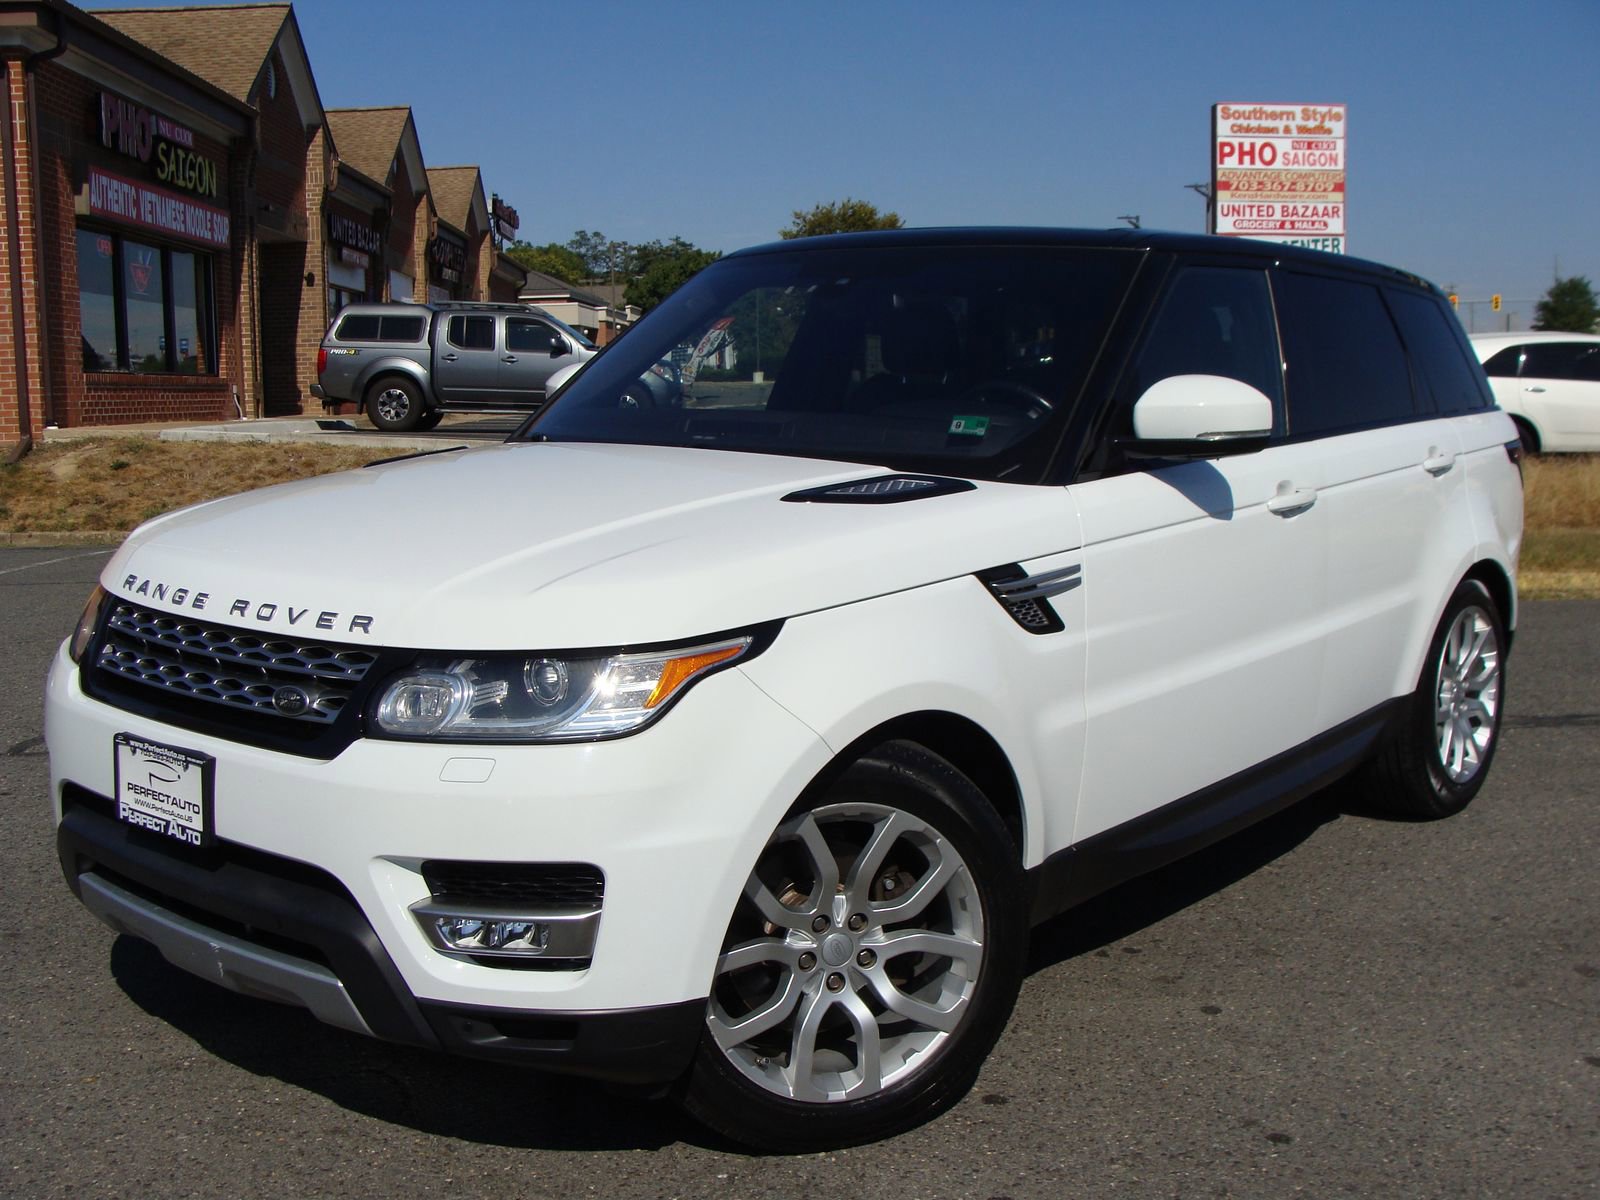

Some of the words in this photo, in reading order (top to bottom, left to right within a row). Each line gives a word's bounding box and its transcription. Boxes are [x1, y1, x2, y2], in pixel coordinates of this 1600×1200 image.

[101, 92, 153, 163] PHO
[1221, 106, 1296, 121] Southern
[1301, 107, 1343, 123] Style
[1230, 123, 1280, 134] Chicken
[1283, 125, 1292, 135] &
[1219, 141, 1278, 167] PHO
[1282, 152, 1339, 167] SAIGON
[157, 141, 217, 198] SAIGON
[1219, 171, 1281, 182] ADVANTAGE
[1284, 171, 1344, 182] COMPUTERS
[90, 172, 137, 220] AUTHENTIC
[139, 188, 186, 231] VIETNAMESE
[186, 203, 211, 240] NOODLE
[213, 214, 230, 245] SOUP
[1221, 204, 1275, 217] UNITED
[1281, 205, 1341, 218] BAZAAR
[331, 213, 357, 246] UNITED
[1235, 220, 1281, 229] GROCERY
[1284, 221, 1292, 229] &
[1295, 220, 1327, 229] HALAL
[122, 573, 210, 609] RANGE
[229, 599, 375, 634] ROVER
